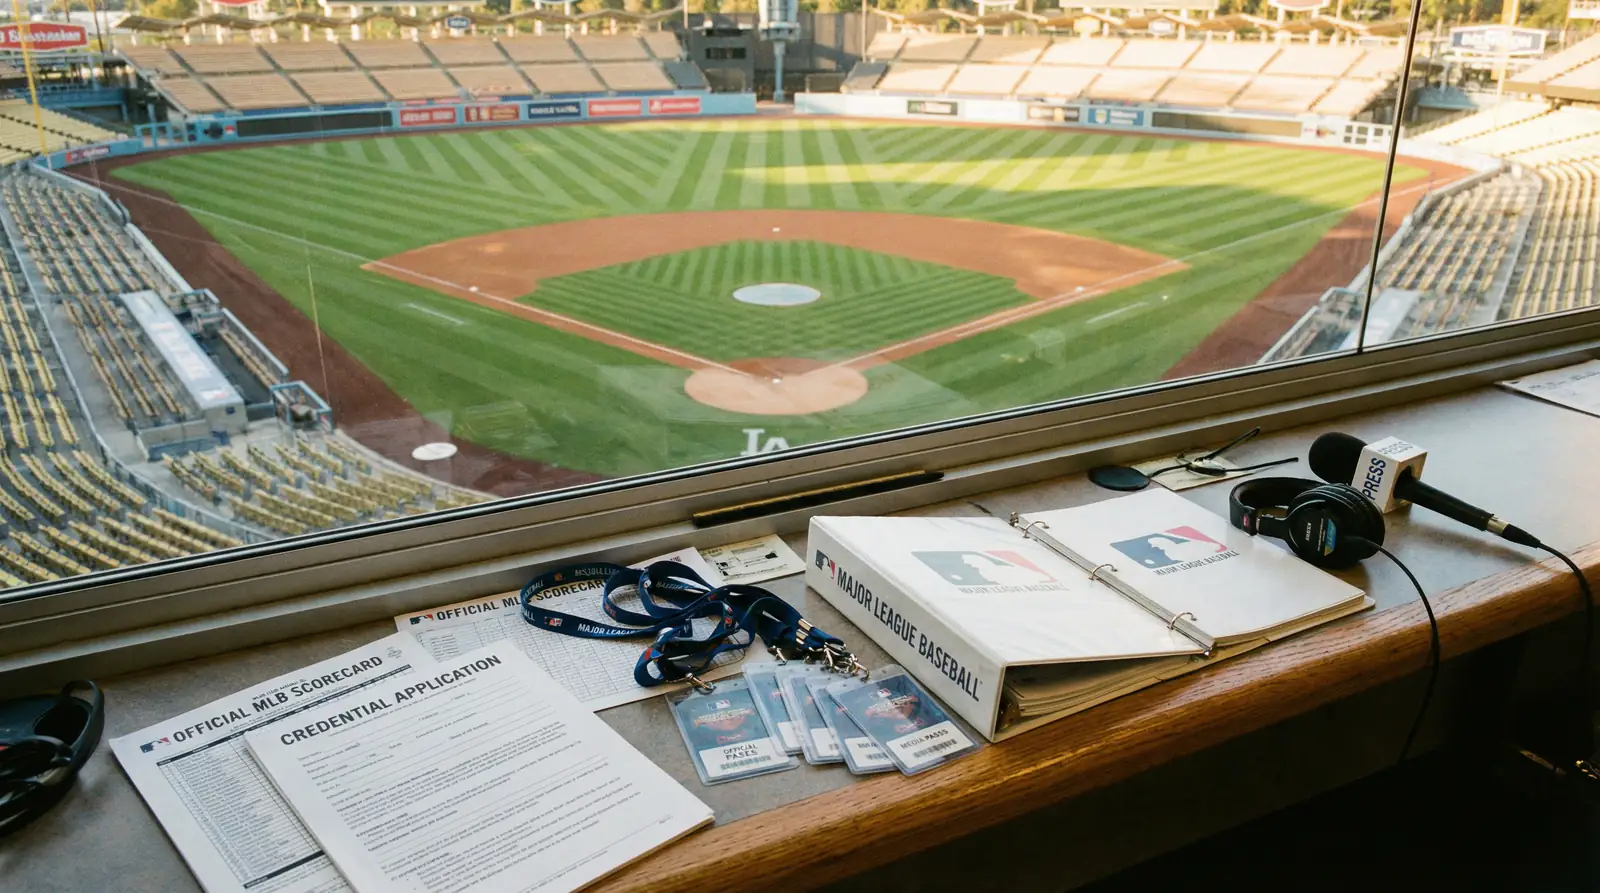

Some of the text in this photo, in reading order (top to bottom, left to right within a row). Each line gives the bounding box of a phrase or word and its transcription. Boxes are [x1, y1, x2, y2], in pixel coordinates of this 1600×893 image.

[1362, 457, 1386, 500] PRESS
[436, 601, 499, 621] OFFICIAL
[502, 597, 522, 608] ML
[535, 579, 606, 601] SCORECAR
[577, 623, 606, 635] MAJOR
[837, 567, 980, 702] MAJOR LEAGUE BASEBALL
[172, 707, 251, 743] OFFICIAL
[252, 692, 289, 714] MLB
[290, 656, 384, 697] SCORECARD
[280, 698, 393, 746] CREDENTIAL
[395, 655, 502, 704] APPLICATION
